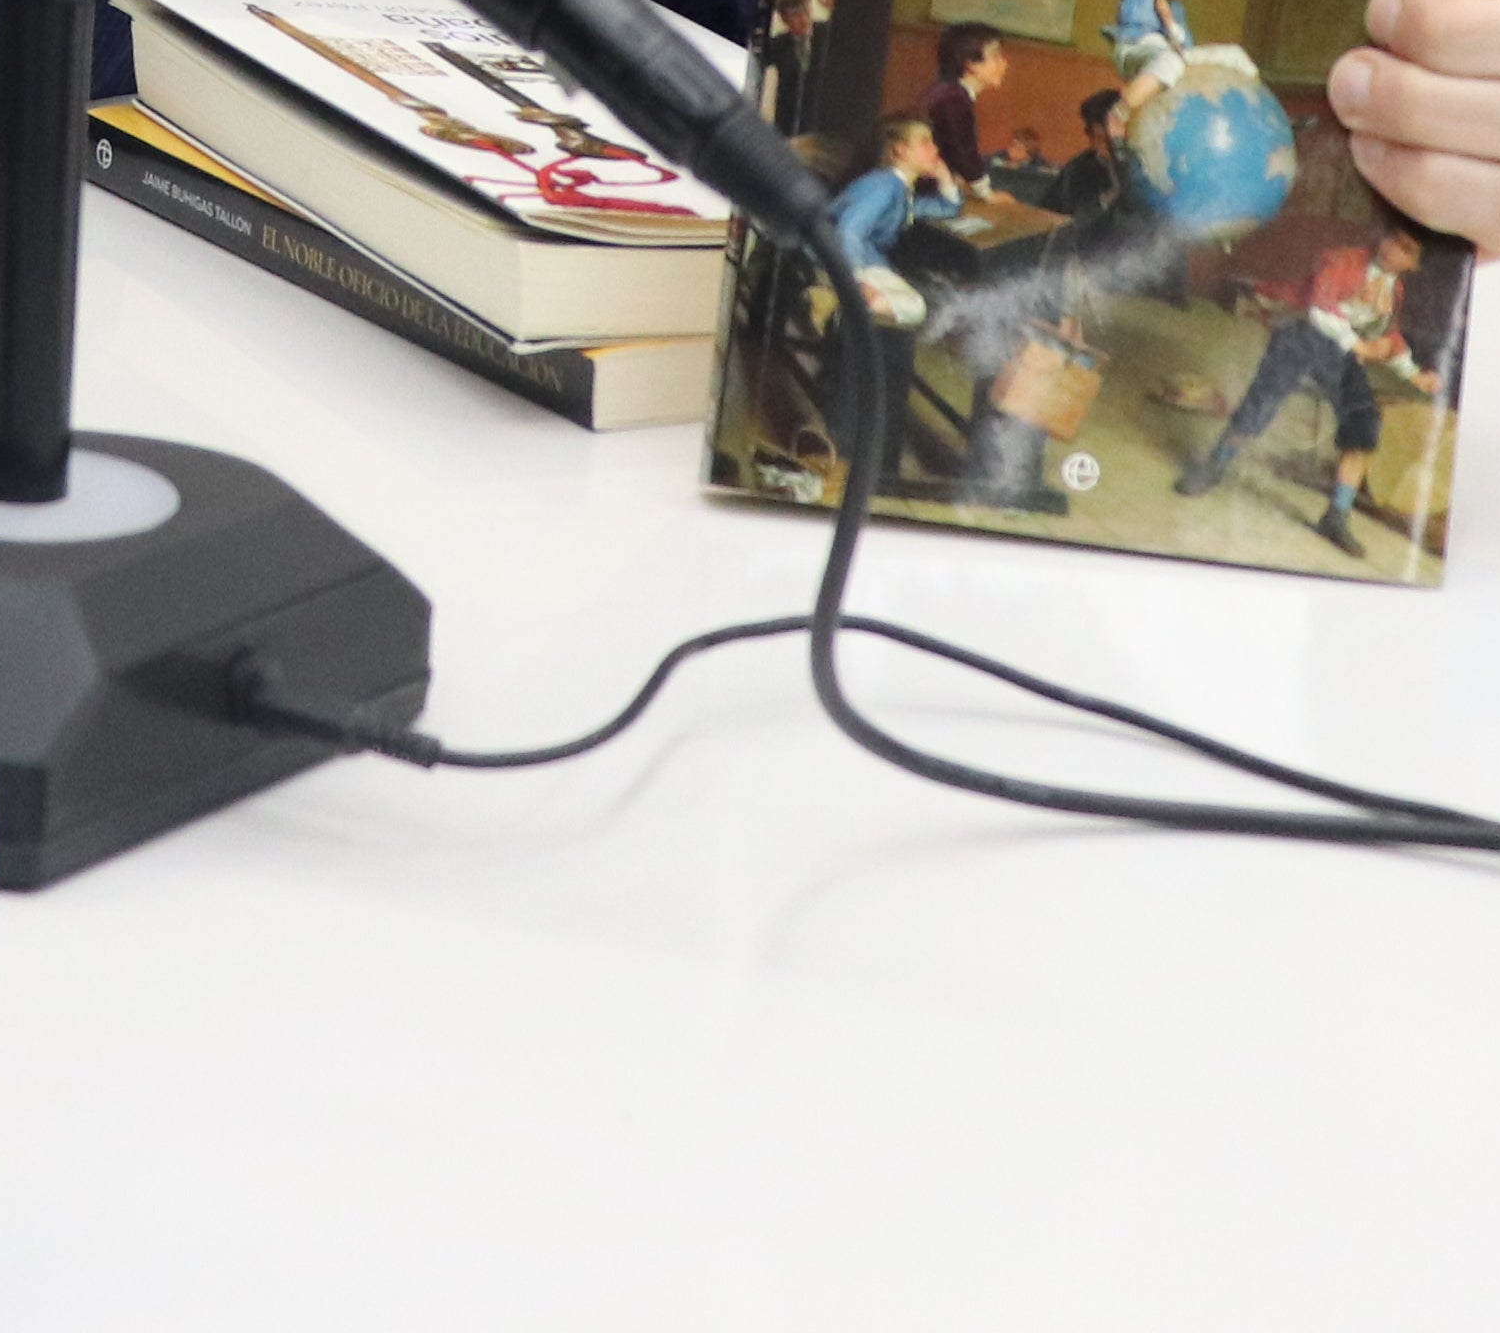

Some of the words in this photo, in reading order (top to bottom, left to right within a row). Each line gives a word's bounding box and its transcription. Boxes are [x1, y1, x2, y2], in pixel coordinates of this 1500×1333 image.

[142, 171, 171, 196] JAIME
[171, 184, 214, 217] BUHIGAS
[214, 205, 252, 236] TALLON
[262, 224, 280, 254] EL
[284, 234, 336, 280] NOBLE
[339, 266, 399, 308] OFICIO
